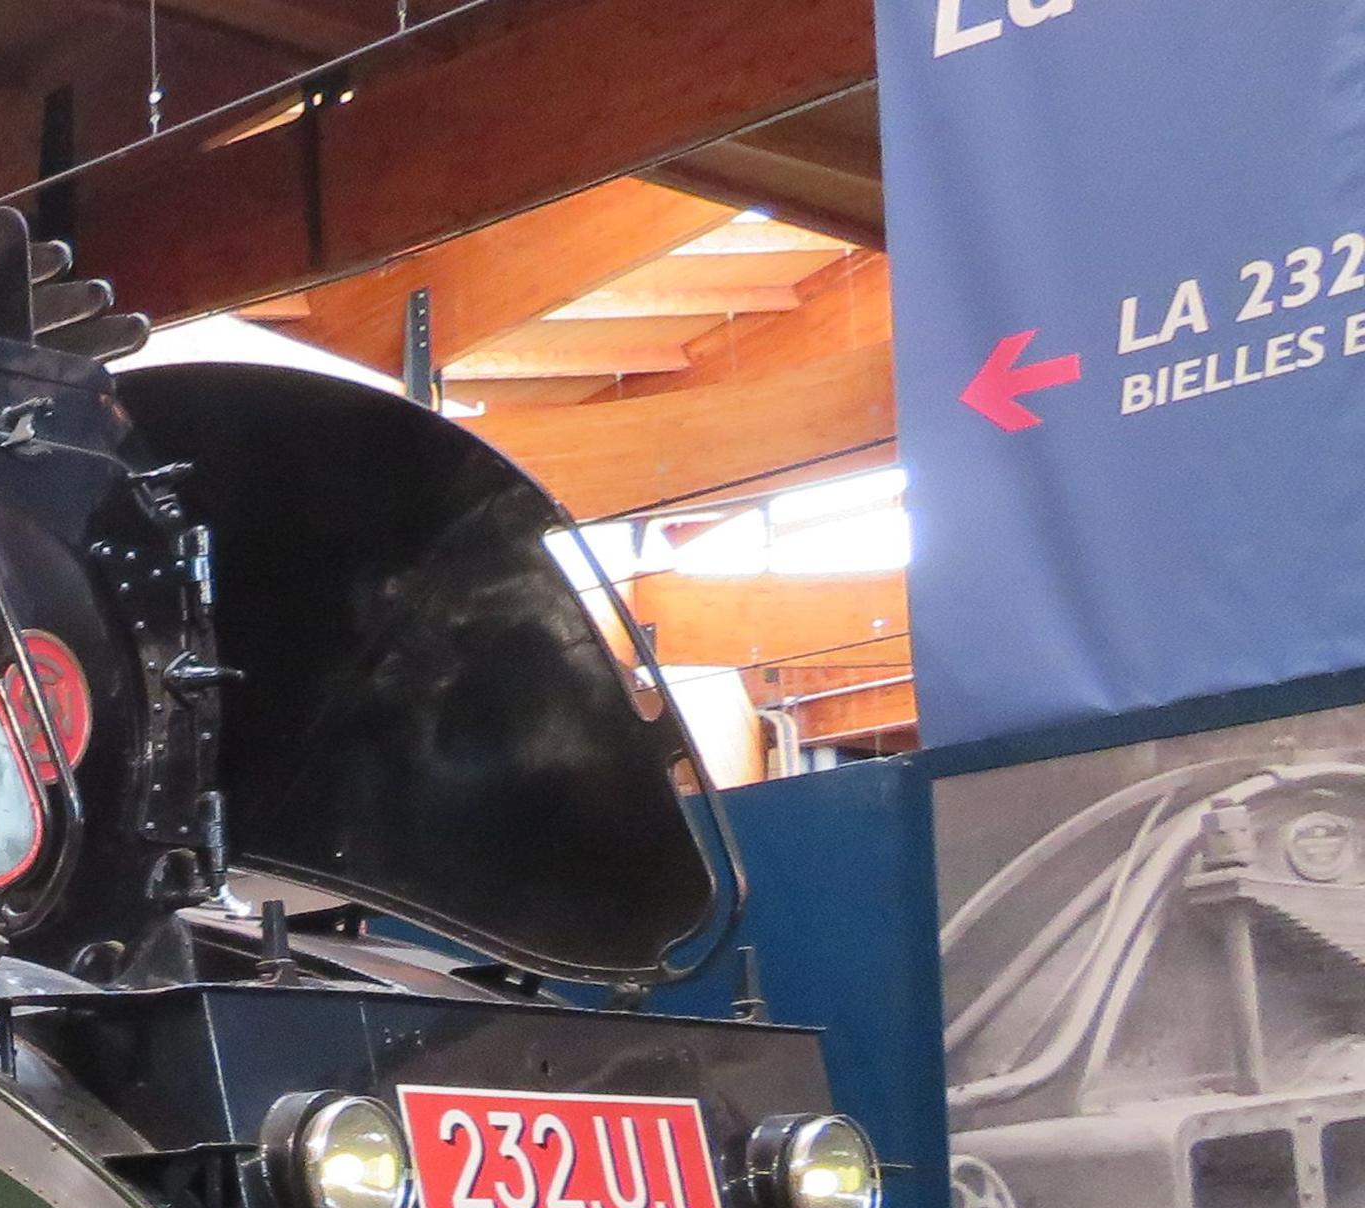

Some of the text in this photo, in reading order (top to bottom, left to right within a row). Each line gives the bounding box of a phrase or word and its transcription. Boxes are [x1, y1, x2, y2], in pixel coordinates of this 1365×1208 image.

[1118, 232, 1365, 355] LA 232
[1120, 325, 1326, 416] BIELLES
